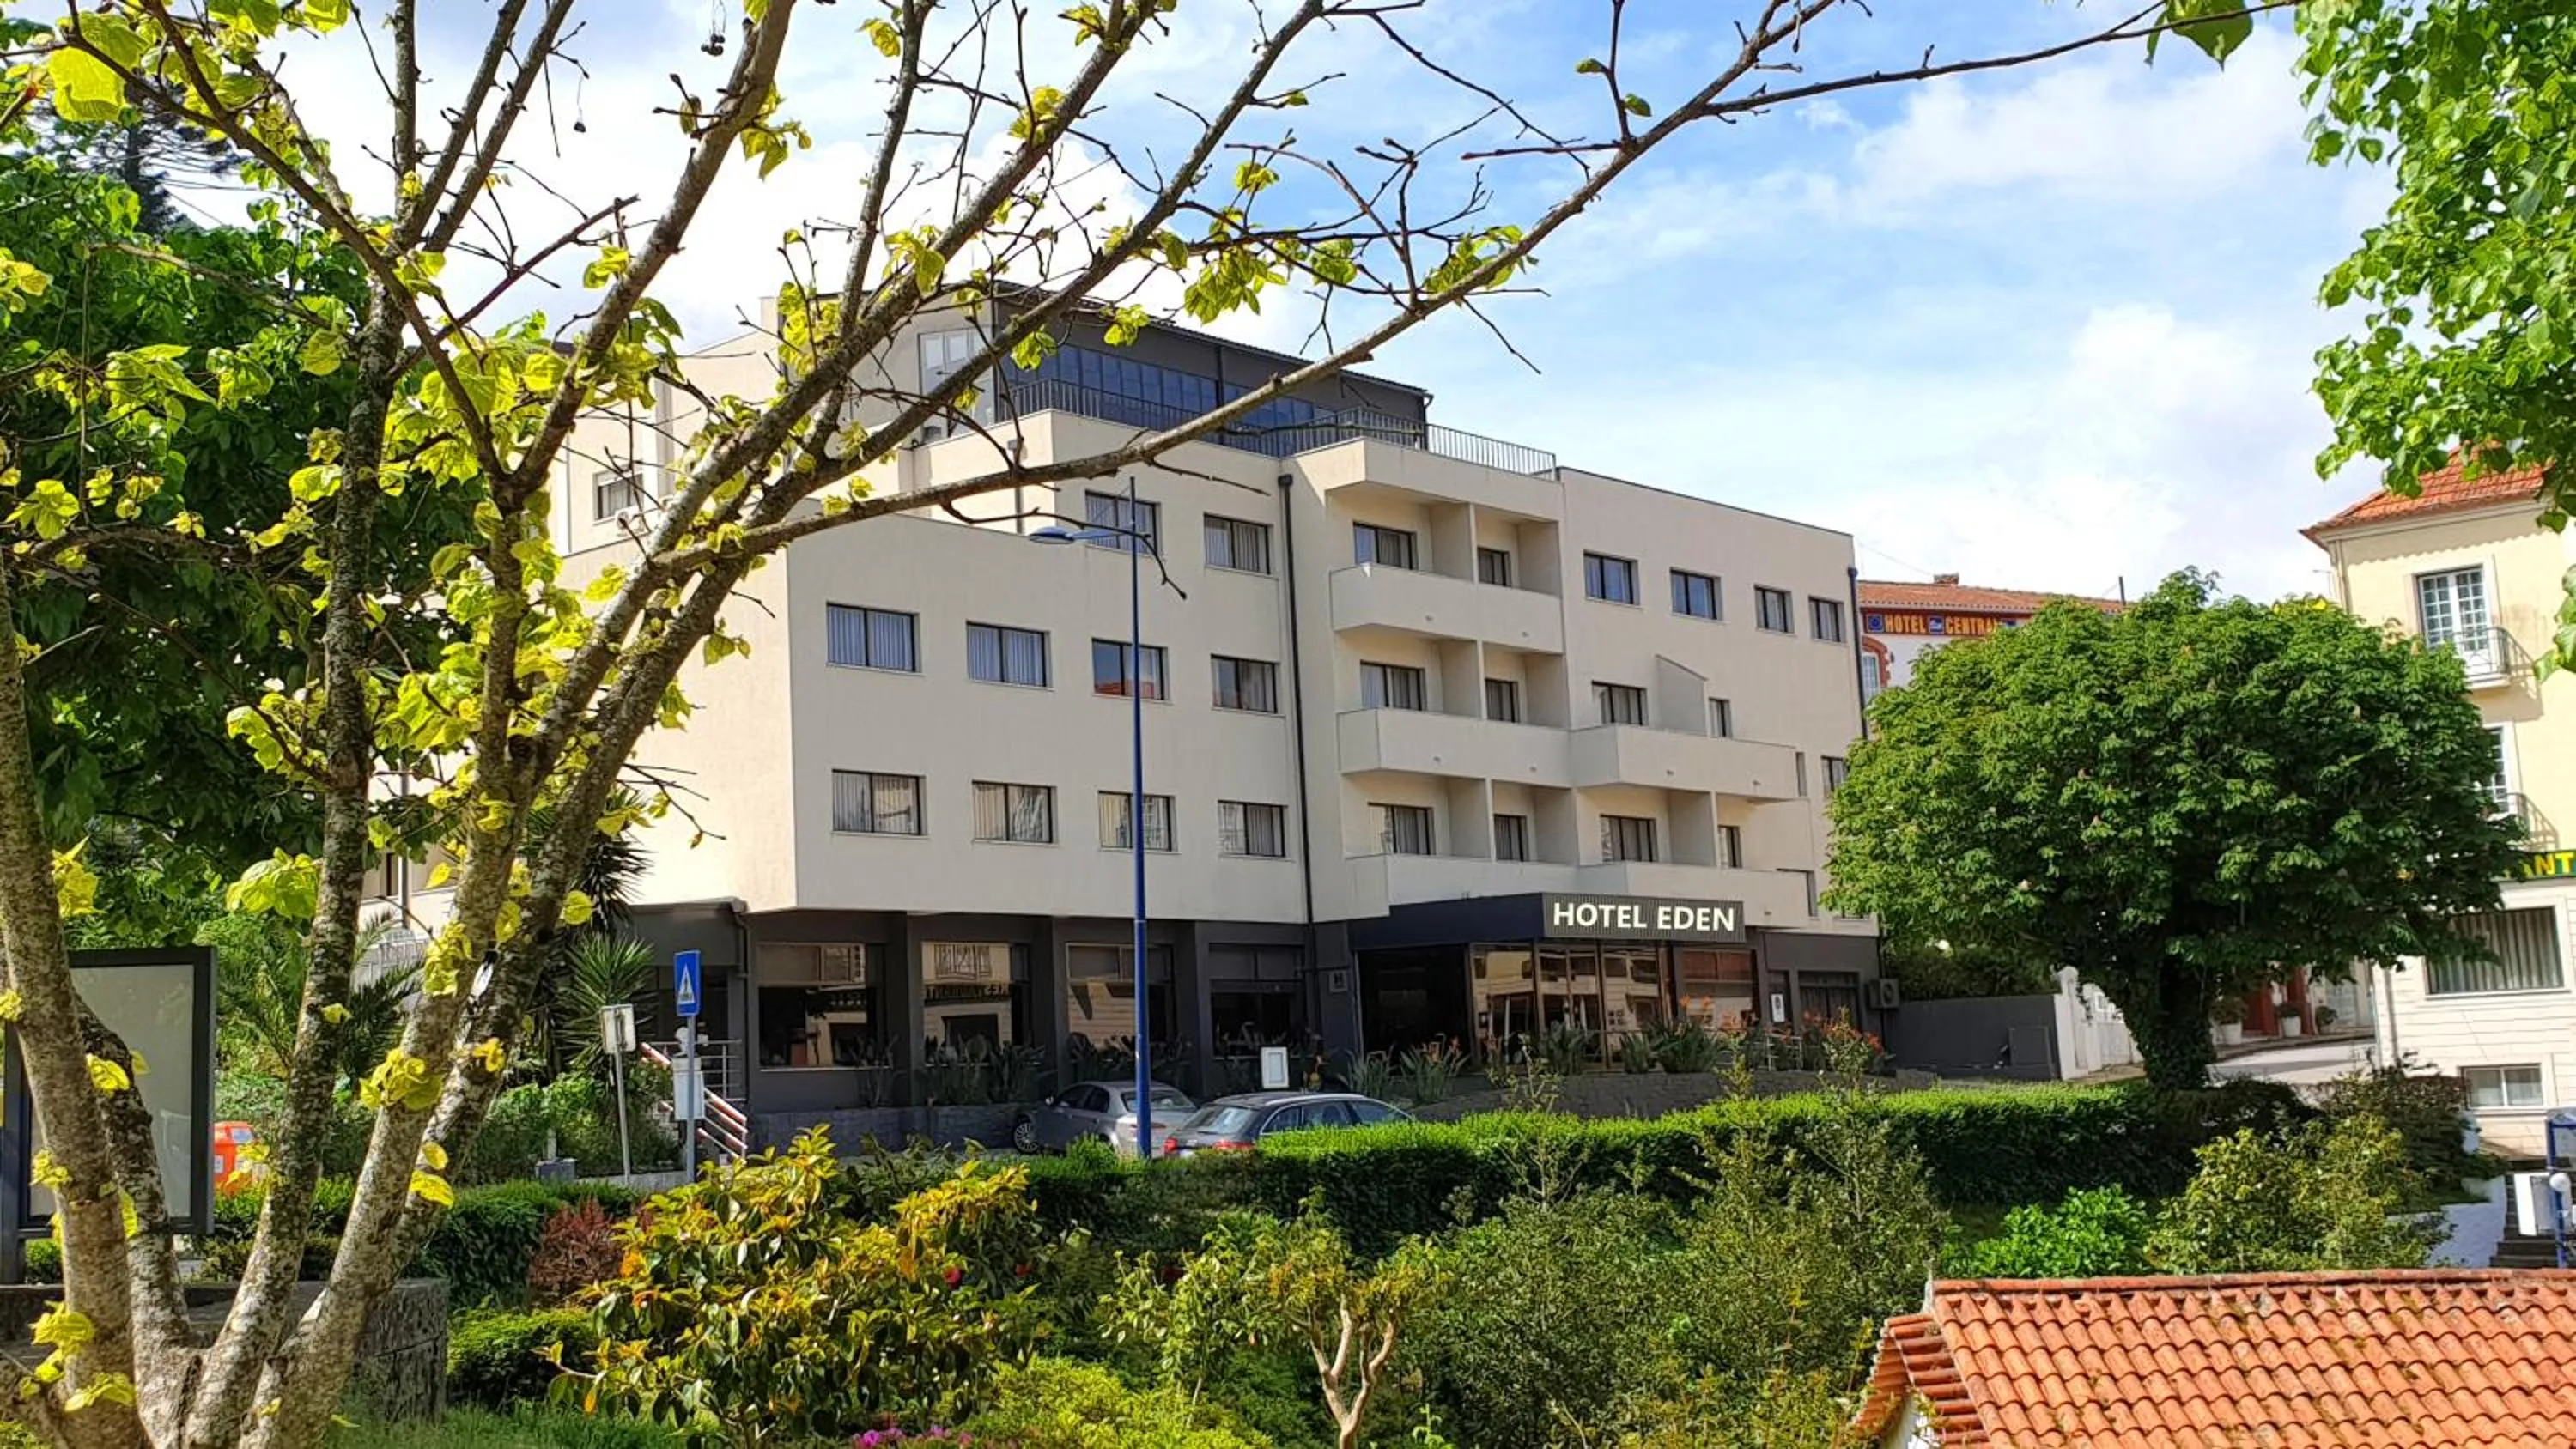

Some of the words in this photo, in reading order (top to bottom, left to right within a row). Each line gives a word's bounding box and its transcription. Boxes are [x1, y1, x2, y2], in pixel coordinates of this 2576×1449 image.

[1884, 614, 1927, 633] HOTEL
[1552, 902, 1648, 929] HOTEL
[1656, 905, 1735, 932] EDEN
